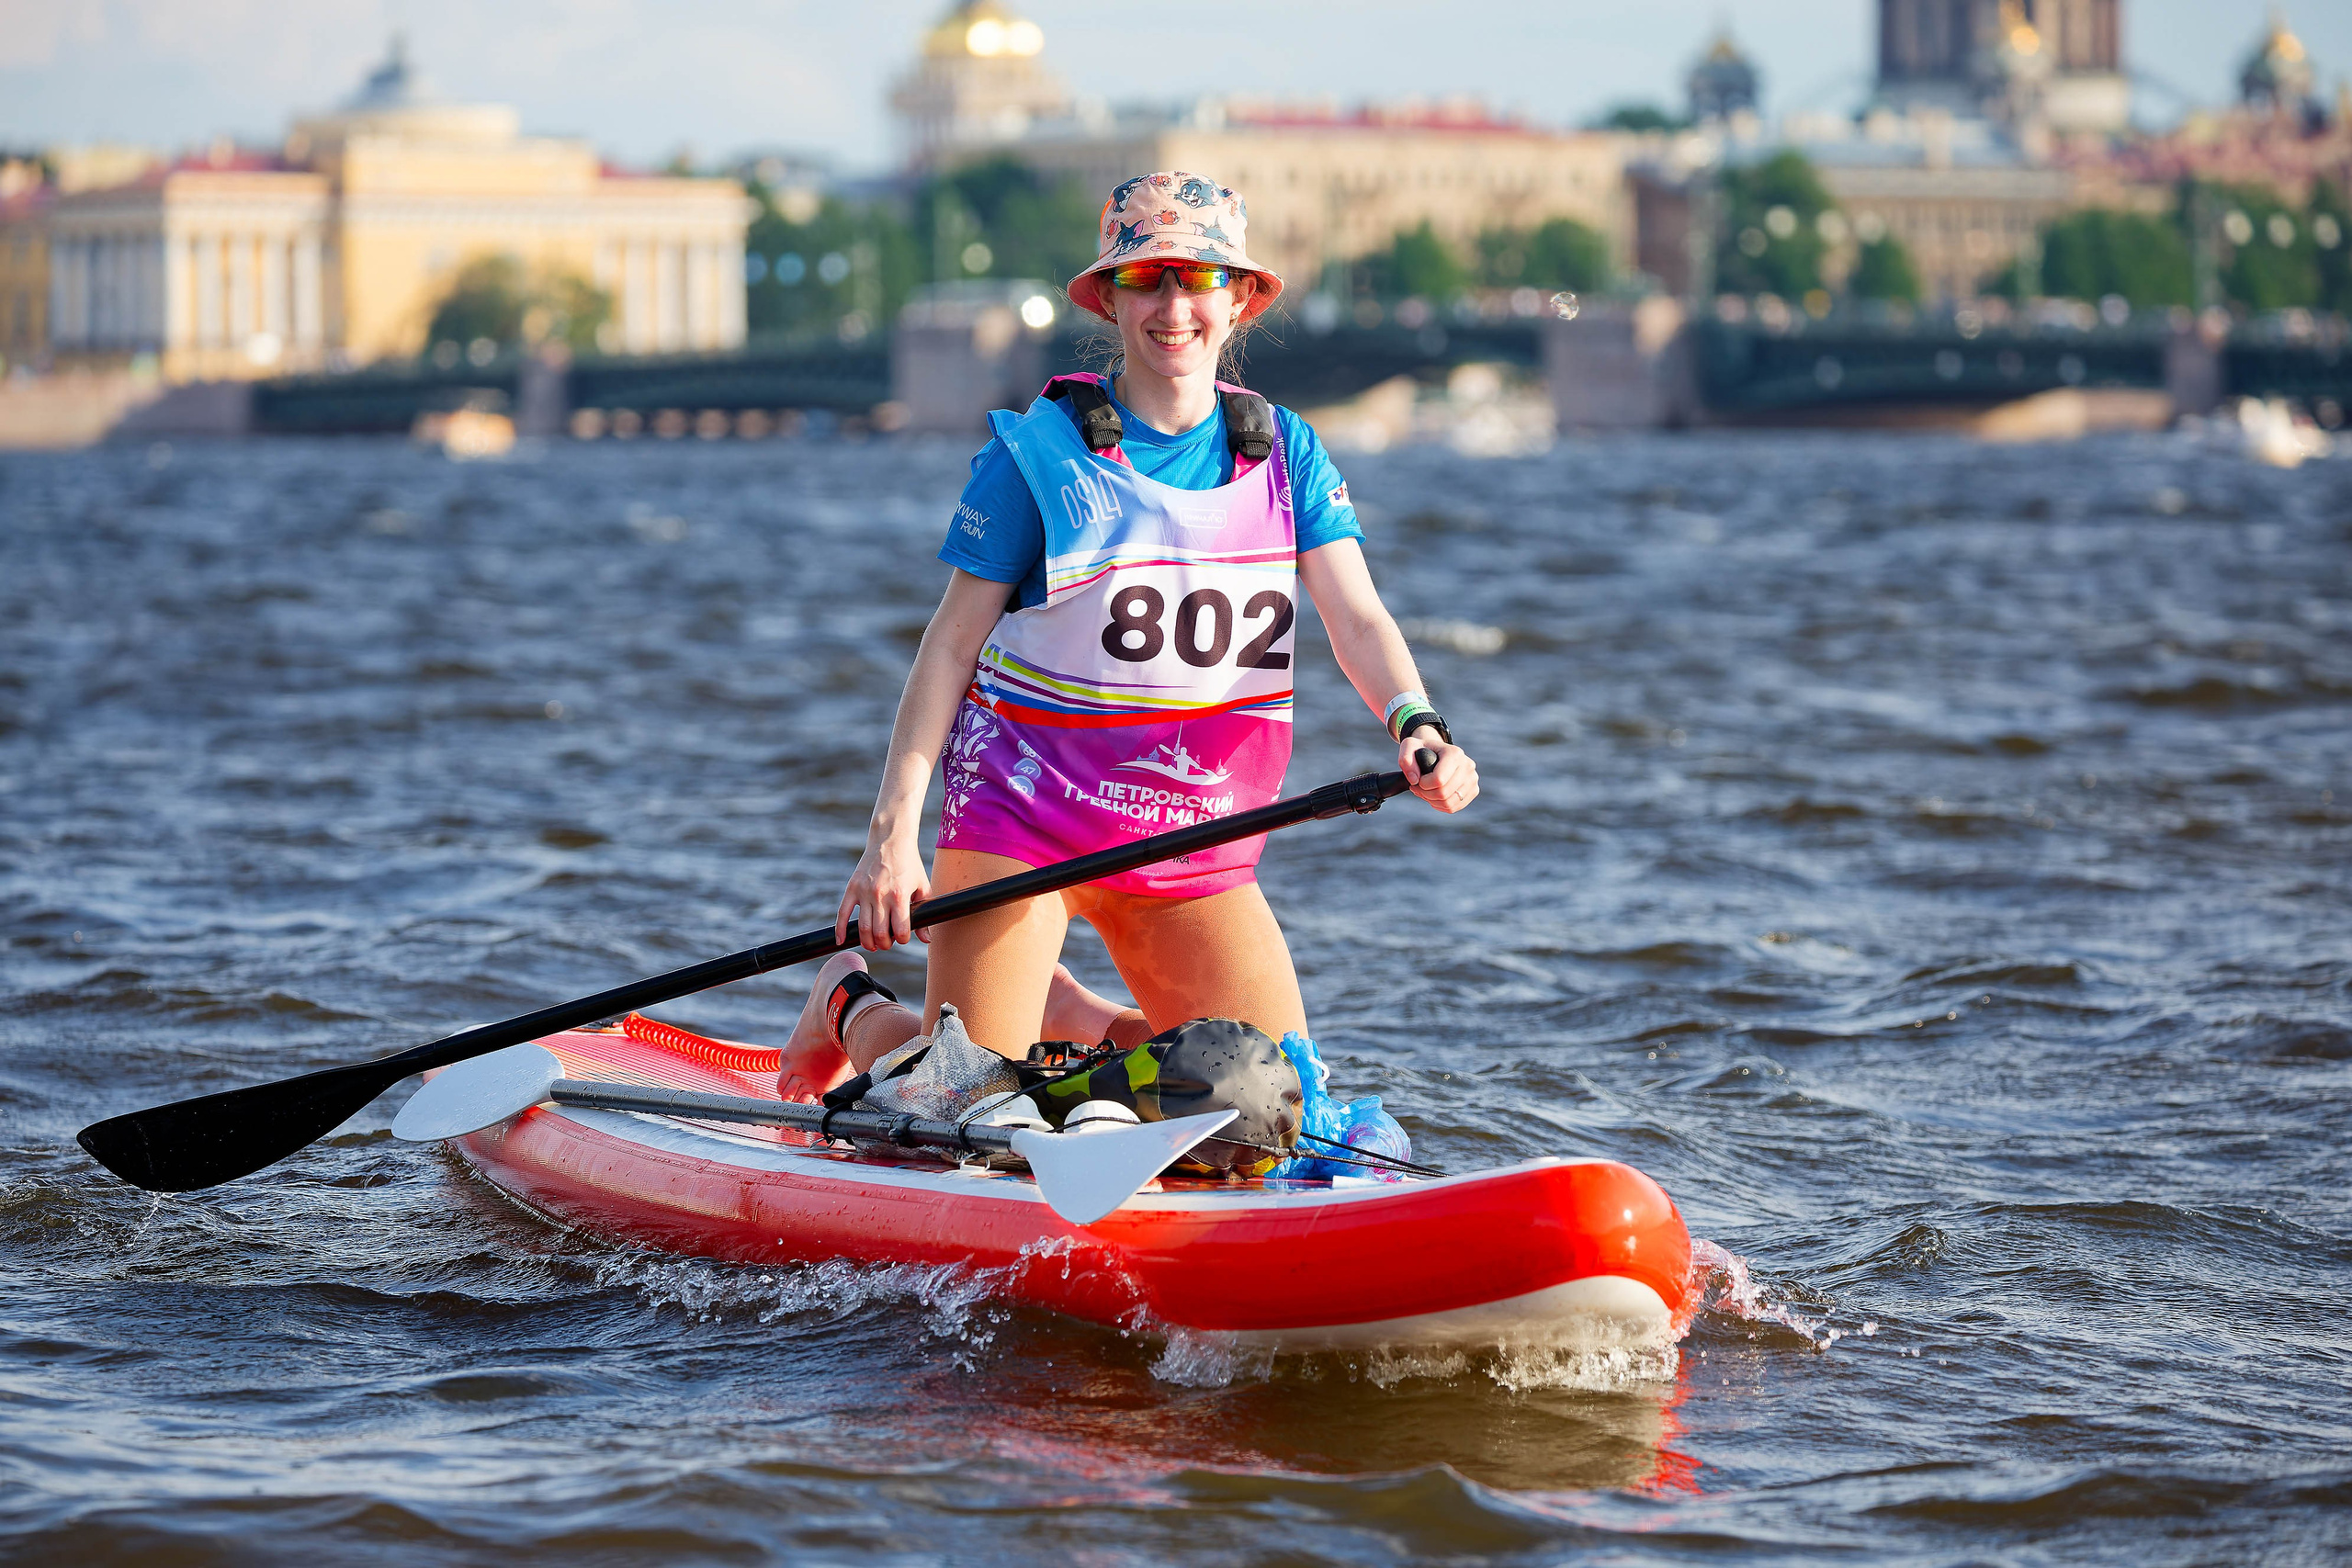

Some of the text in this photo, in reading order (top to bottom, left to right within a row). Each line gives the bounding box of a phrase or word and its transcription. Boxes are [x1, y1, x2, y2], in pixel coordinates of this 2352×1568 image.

[959, 520, 986, 540] RUN
[1101, 584, 1295, 671] 802
[1020, 765, 1036, 775] 47
[1064, 782, 1160, 823] ГРЕБНОЙ
[1098, 780, 1235, 813] ПЕТРОВСКИЙ
